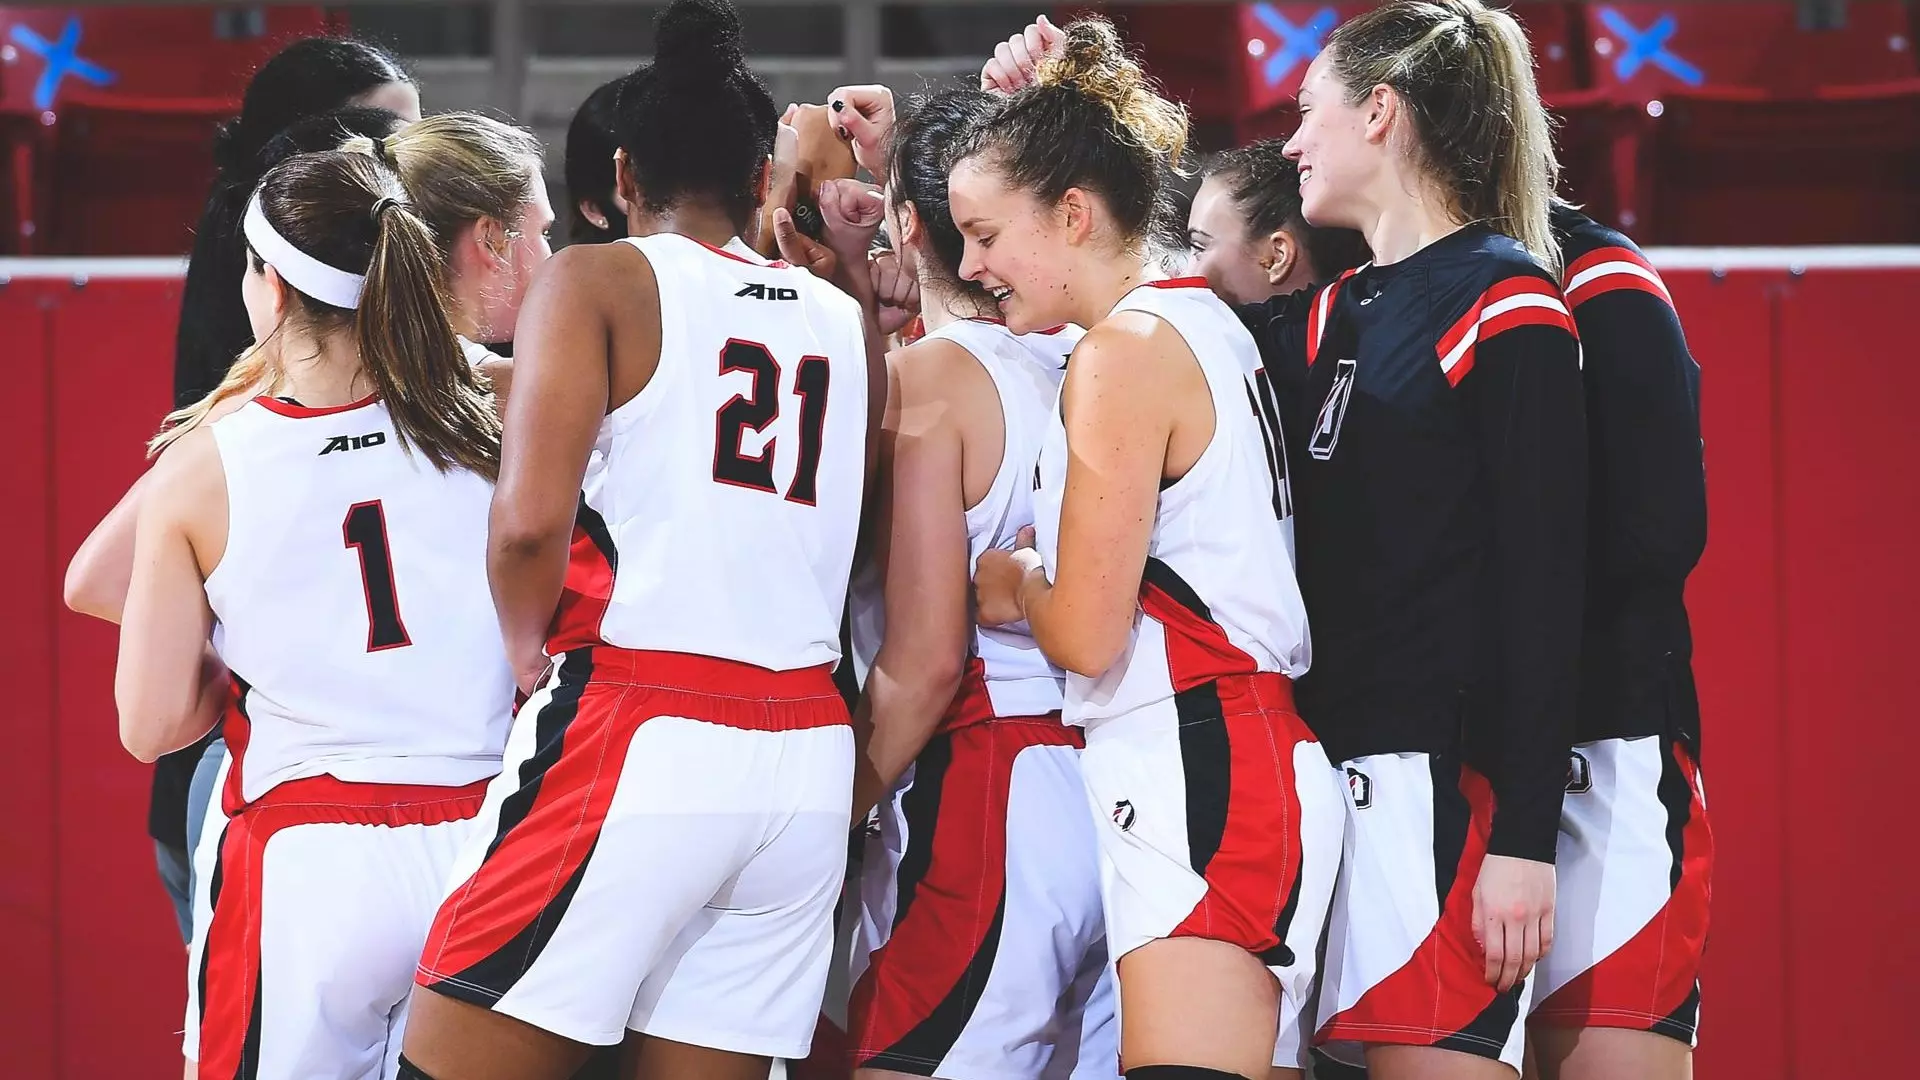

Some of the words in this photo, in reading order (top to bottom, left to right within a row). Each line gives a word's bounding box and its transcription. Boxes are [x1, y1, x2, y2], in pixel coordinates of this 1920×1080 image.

[734, 282, 798, 301] A10
[318, 432, 386, 456] A10
[713, 337, 831, 507] 21
[342, 499, 413, 653] 1
